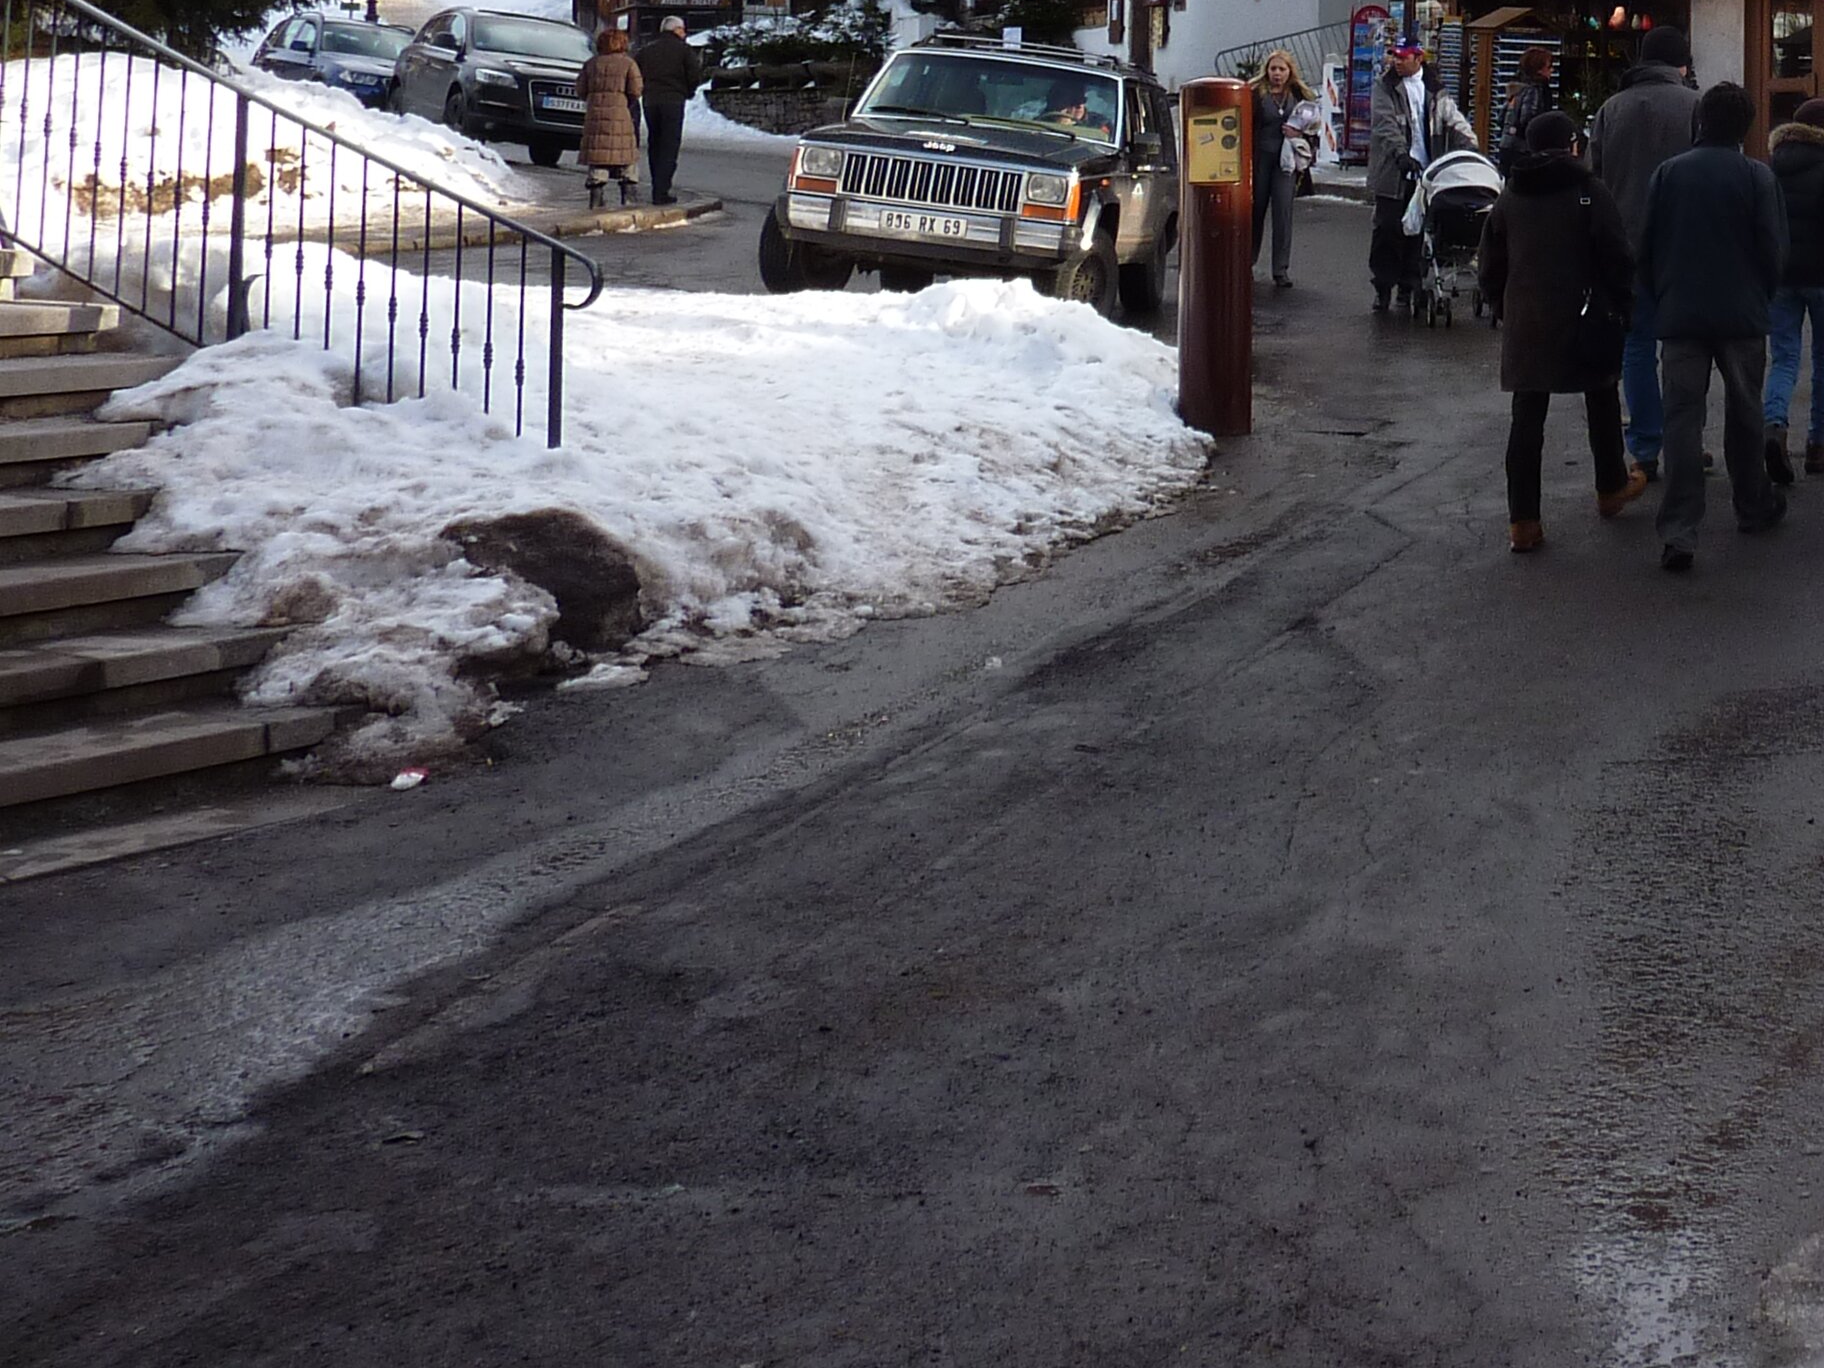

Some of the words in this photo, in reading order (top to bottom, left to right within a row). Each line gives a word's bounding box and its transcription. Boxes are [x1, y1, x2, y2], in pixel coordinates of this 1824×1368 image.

[922, 141, 956, 153] Jeep
[918, 215, 937, 233] RX
[943, 218, 962, 236] 69
